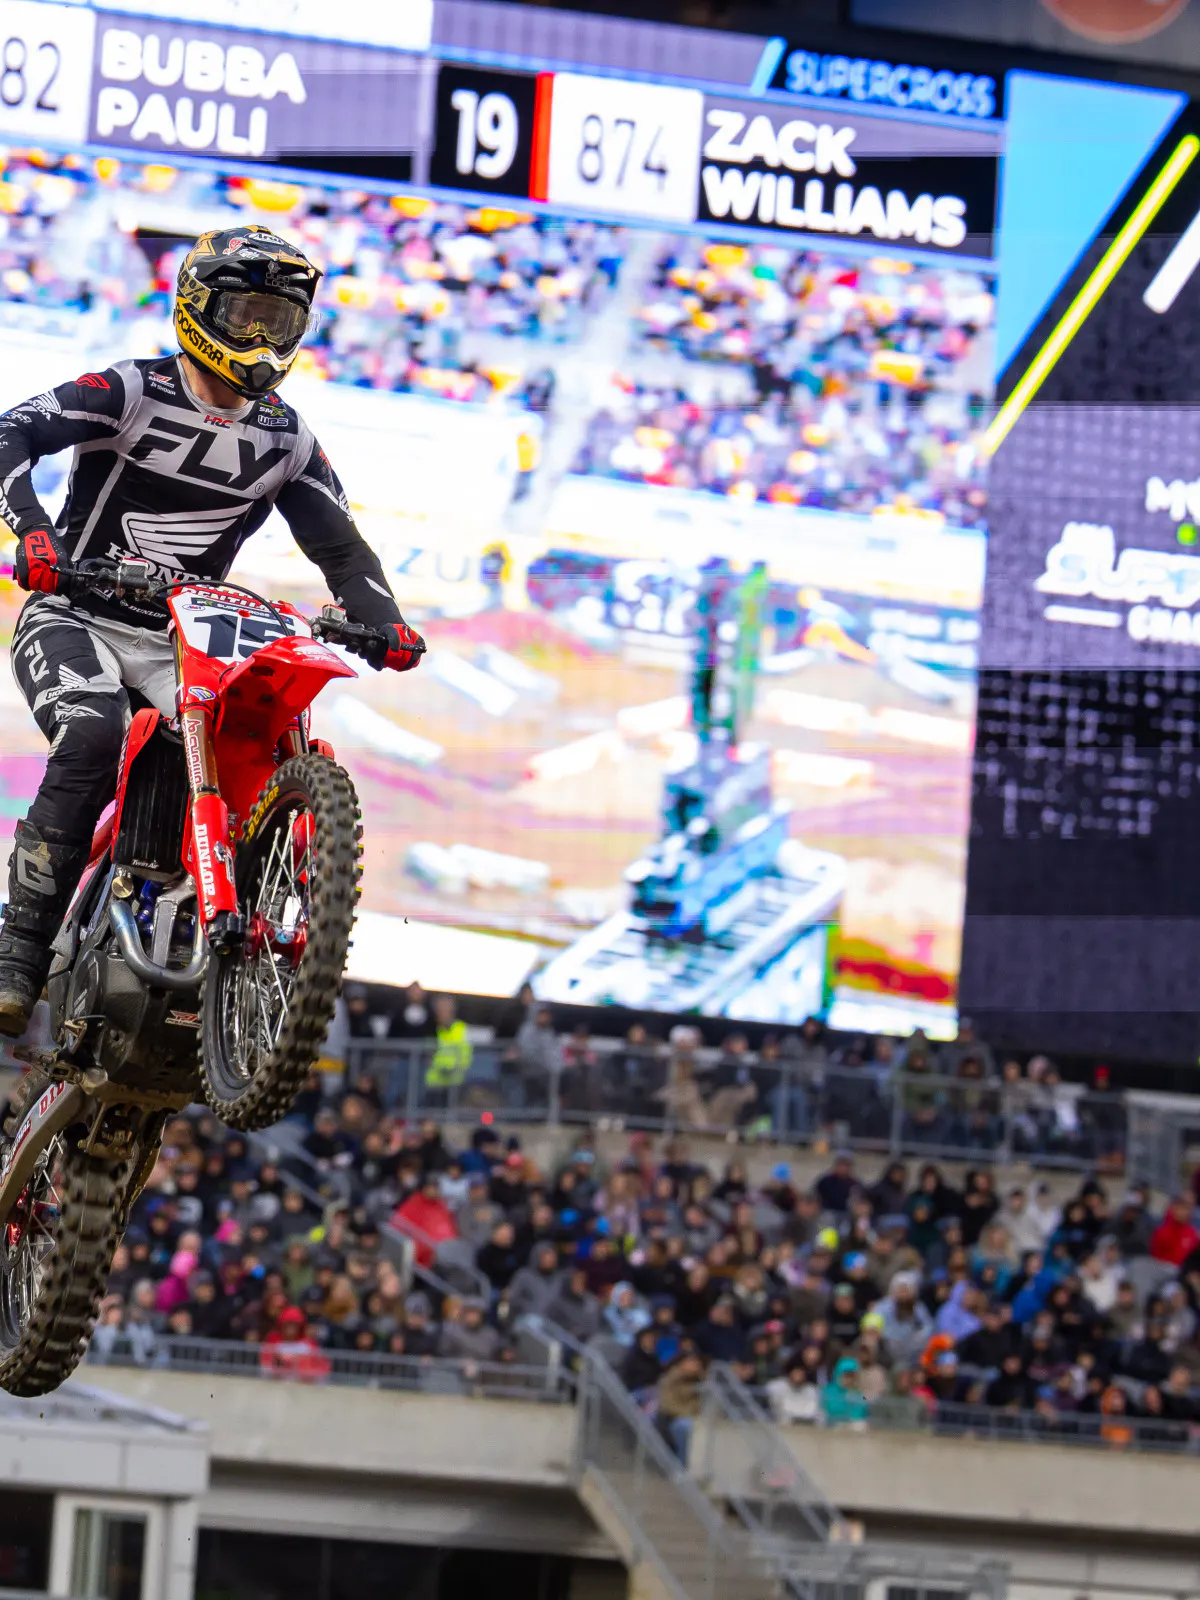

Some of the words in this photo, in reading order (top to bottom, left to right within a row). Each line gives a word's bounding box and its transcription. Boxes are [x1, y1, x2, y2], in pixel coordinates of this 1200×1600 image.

[101, 29, 307, 104] BUBBA
[785, 49, 996, 119] SUPERCROSS
[97, 87, 268, 157] PAULI
[451, 89, 519, 179] 19
[578, 113, 668, 191] 874
[705, 109, 856, 177] ZACK
[702, 166, 966, 247] WILLIAMS
[127, 416, 293, 491] FLY
[204, 415, 233, 429] HRC
[258, 414, 289, 427] WPS
[29, 534, 50, 559] FLY
[127, 605, 167, 619] DUNLOP
[194, 614, 296, 659] 15
[24, 639, 50, 684] FLY
[194, 824, 216, 896] DUNLOP
